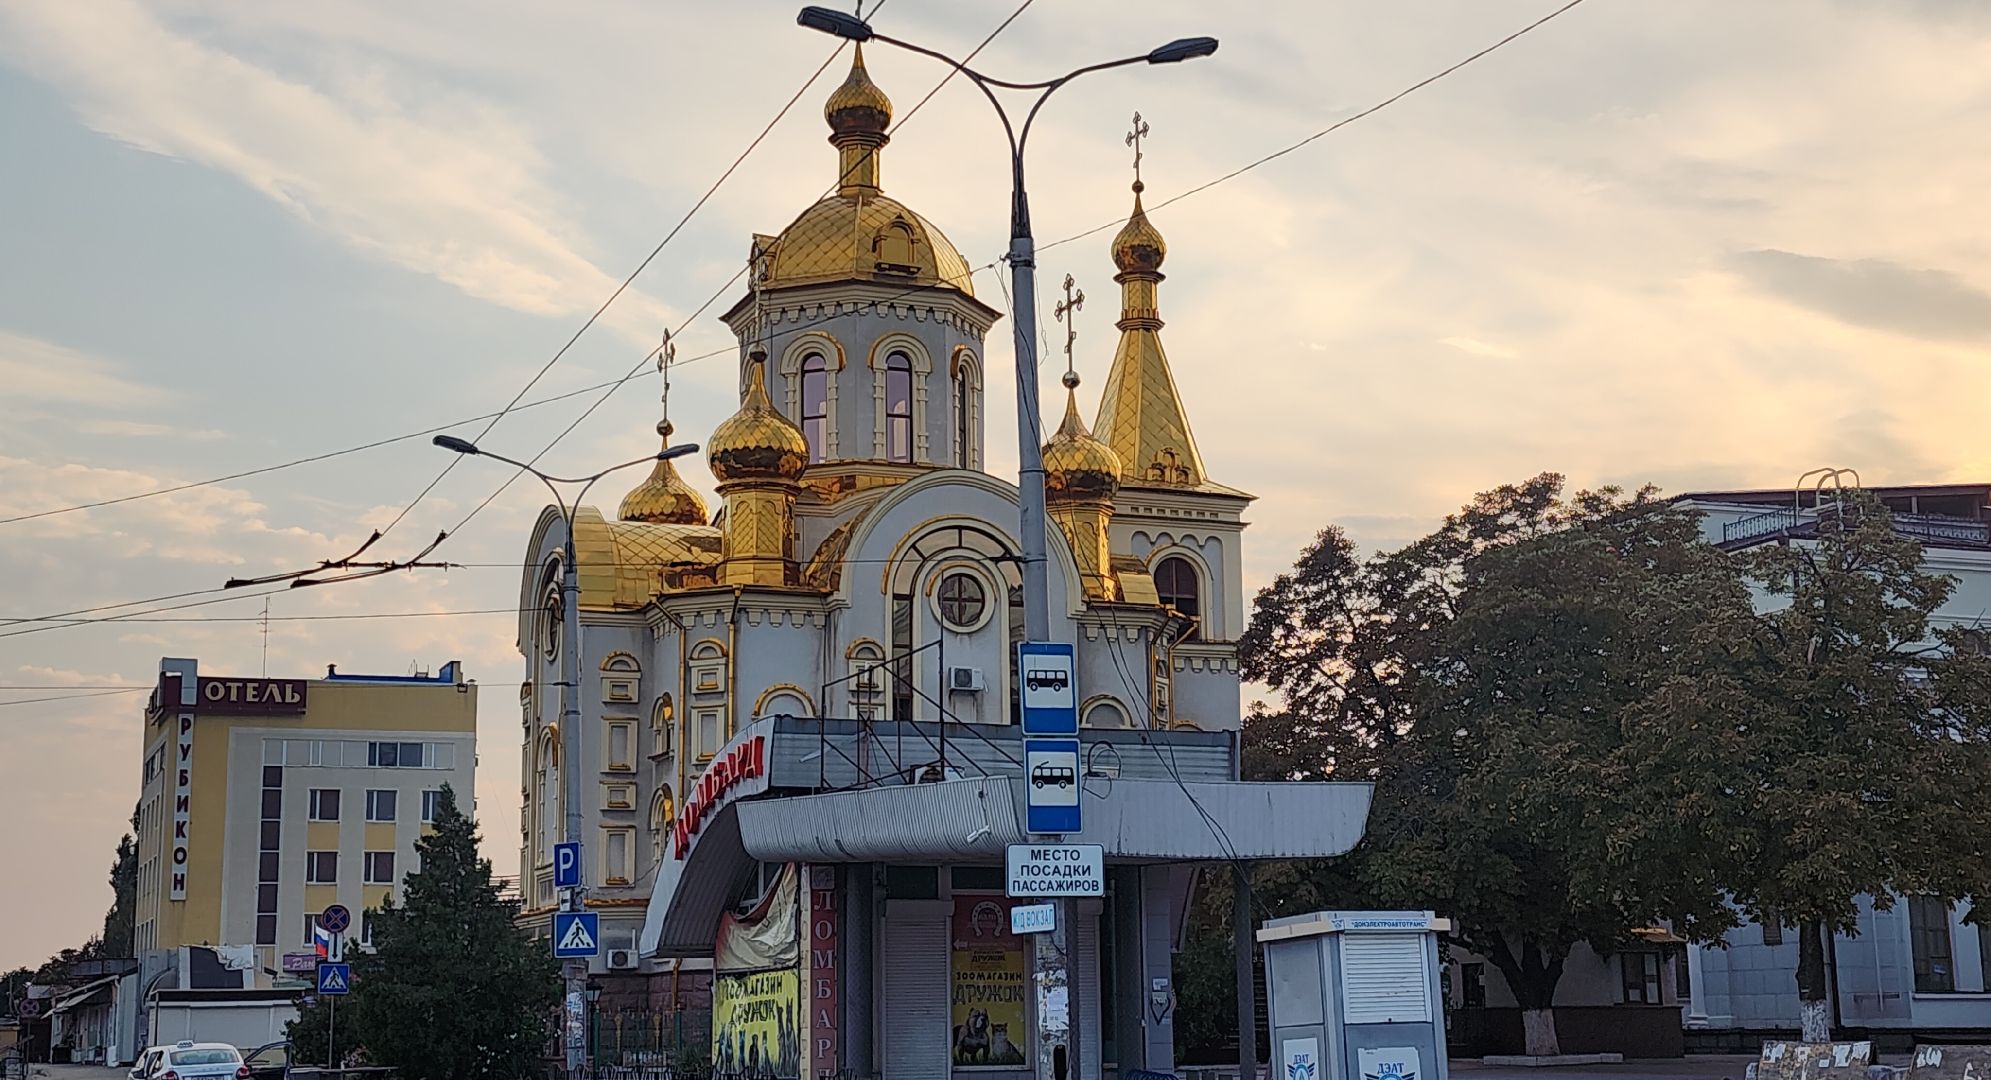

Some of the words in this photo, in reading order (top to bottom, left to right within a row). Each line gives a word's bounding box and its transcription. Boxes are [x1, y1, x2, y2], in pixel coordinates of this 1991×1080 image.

[205, 681, 300, 703] ОТЕЛЬ
[173, 717, 192, 891] РУБИКОН
[674, 735, 765, 860] ЛОМБАРД
[559, 848, 574, 882] P
[1030, 849, 1081, 861] МЕСТО
[1020, 864, 1091, 878] ПОСАДКИ
[1012, 880, 1100, 892] ПАССАЖИРОВ
[956, 971, 1022, 981] ЗООМАГАЗИН
[953, 984, 1024, 1005] ДРУЖОК
